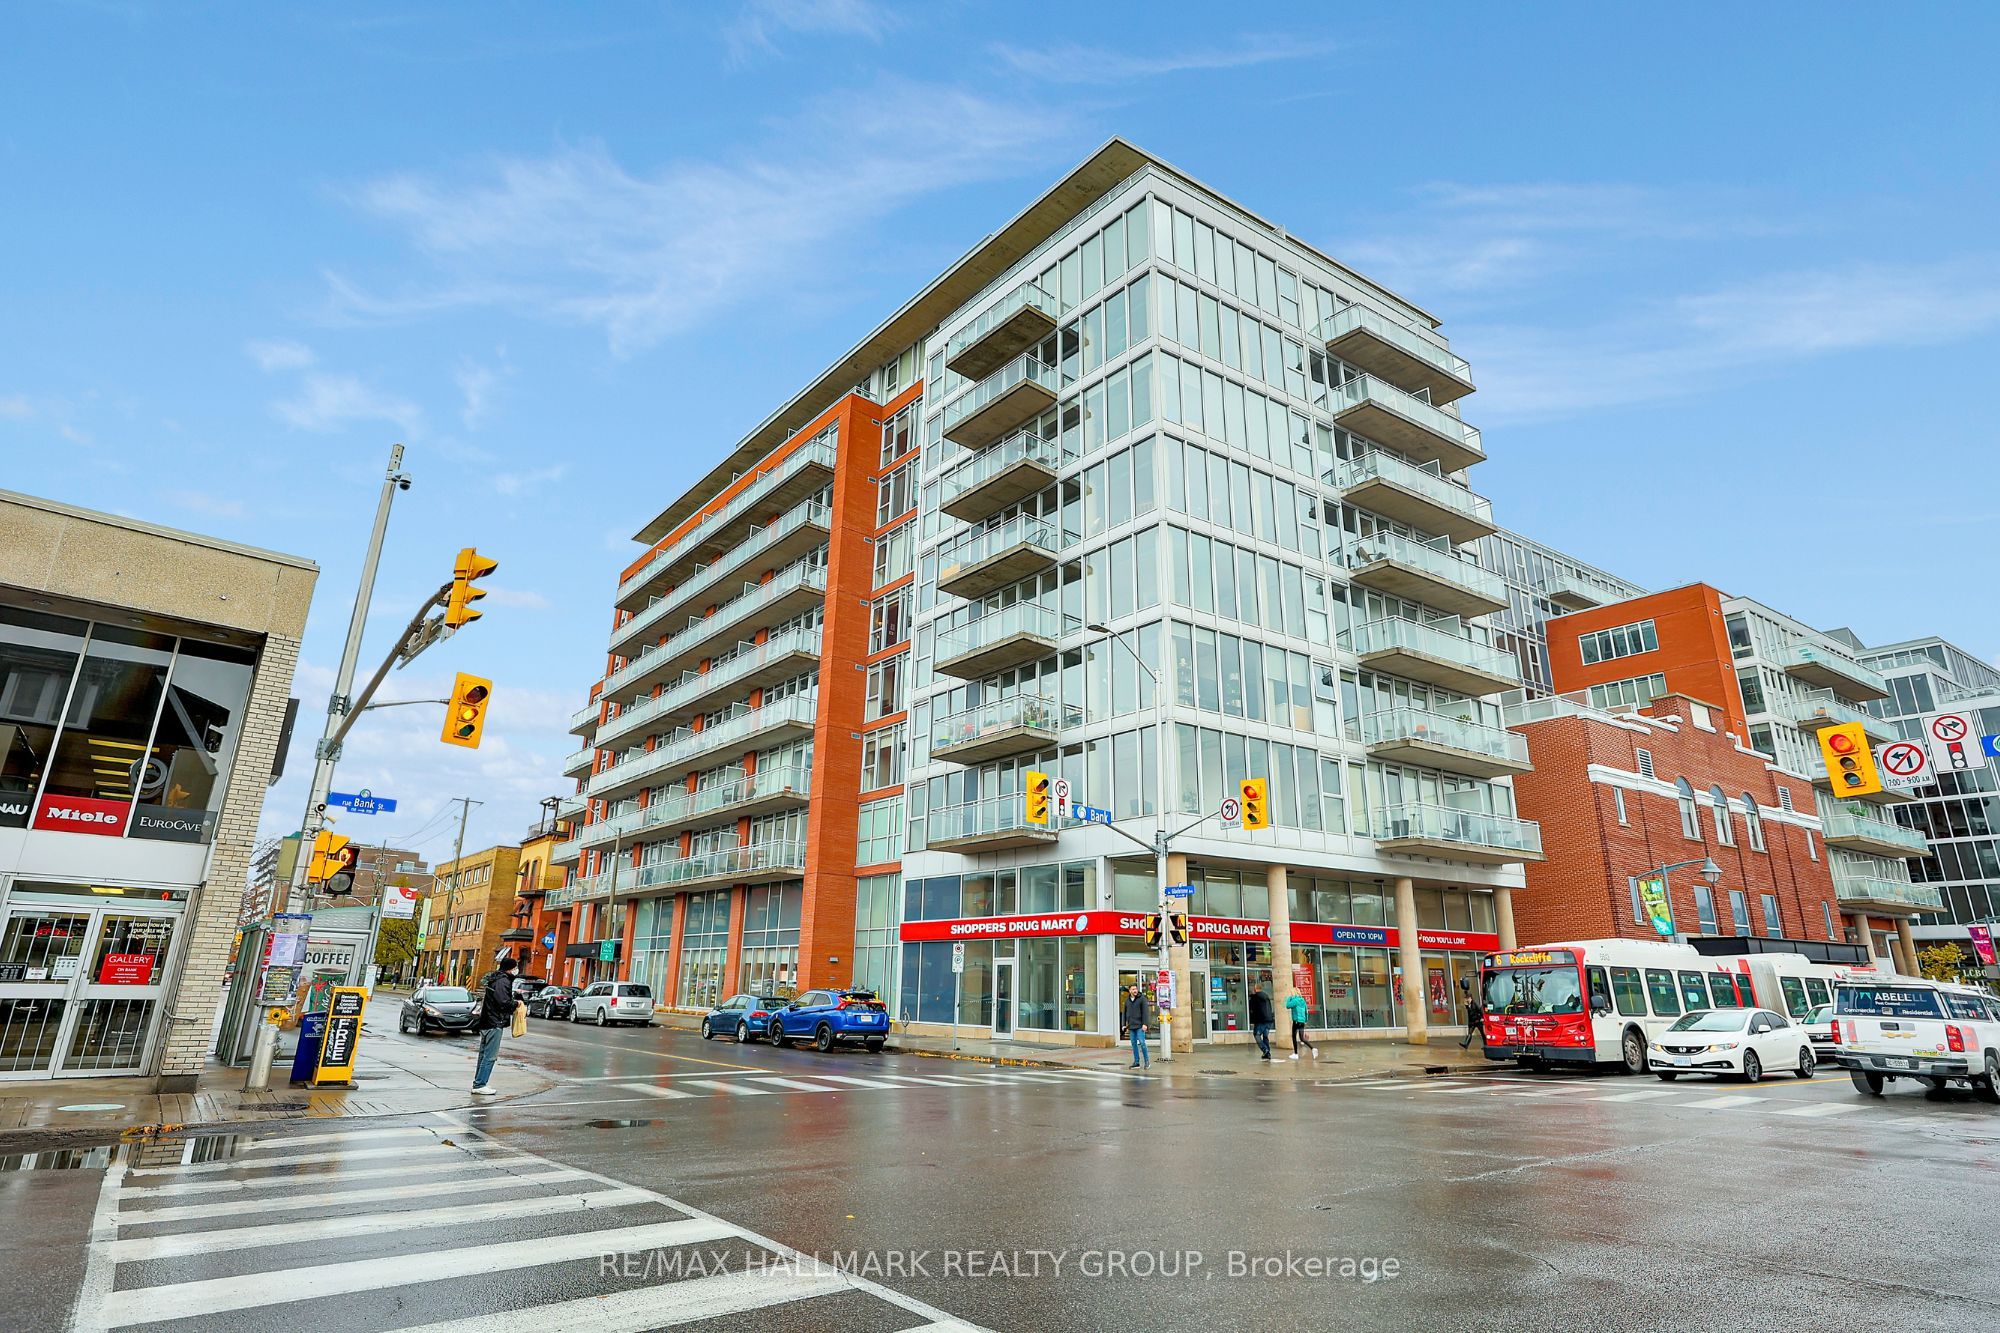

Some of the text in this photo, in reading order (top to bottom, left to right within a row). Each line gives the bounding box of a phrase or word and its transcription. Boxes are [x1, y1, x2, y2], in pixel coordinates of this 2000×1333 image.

[1888, 777, 1901, 786] 7:00
[1907, 775, 1920, 784] 9:00
[354, 798, 375, 809] Bank
[46, 807, 118, 824] Miele
[1090, 810, 1110, 824] Bank
[950, 919, 1074, 934] SHOPPERS DRUG MART
[1197, 922, 1230, 933] DRUG
[1232, 924, 1265, 935] MART
[1336, 931, 1356, 939] OPEN
[1367, 932, 1384, 940] 10PM
[108, 955, 151, 964] GALLERY
[304, 951, 351, 965] COFFEE
[1496, 952, 1552, 965] 6 Rockcliffe
[1963, 969, 1987, 977] LCBO
[1874, 992, 1912, 1002] ABELL
[331, 1018, 351, 1060] FREE
